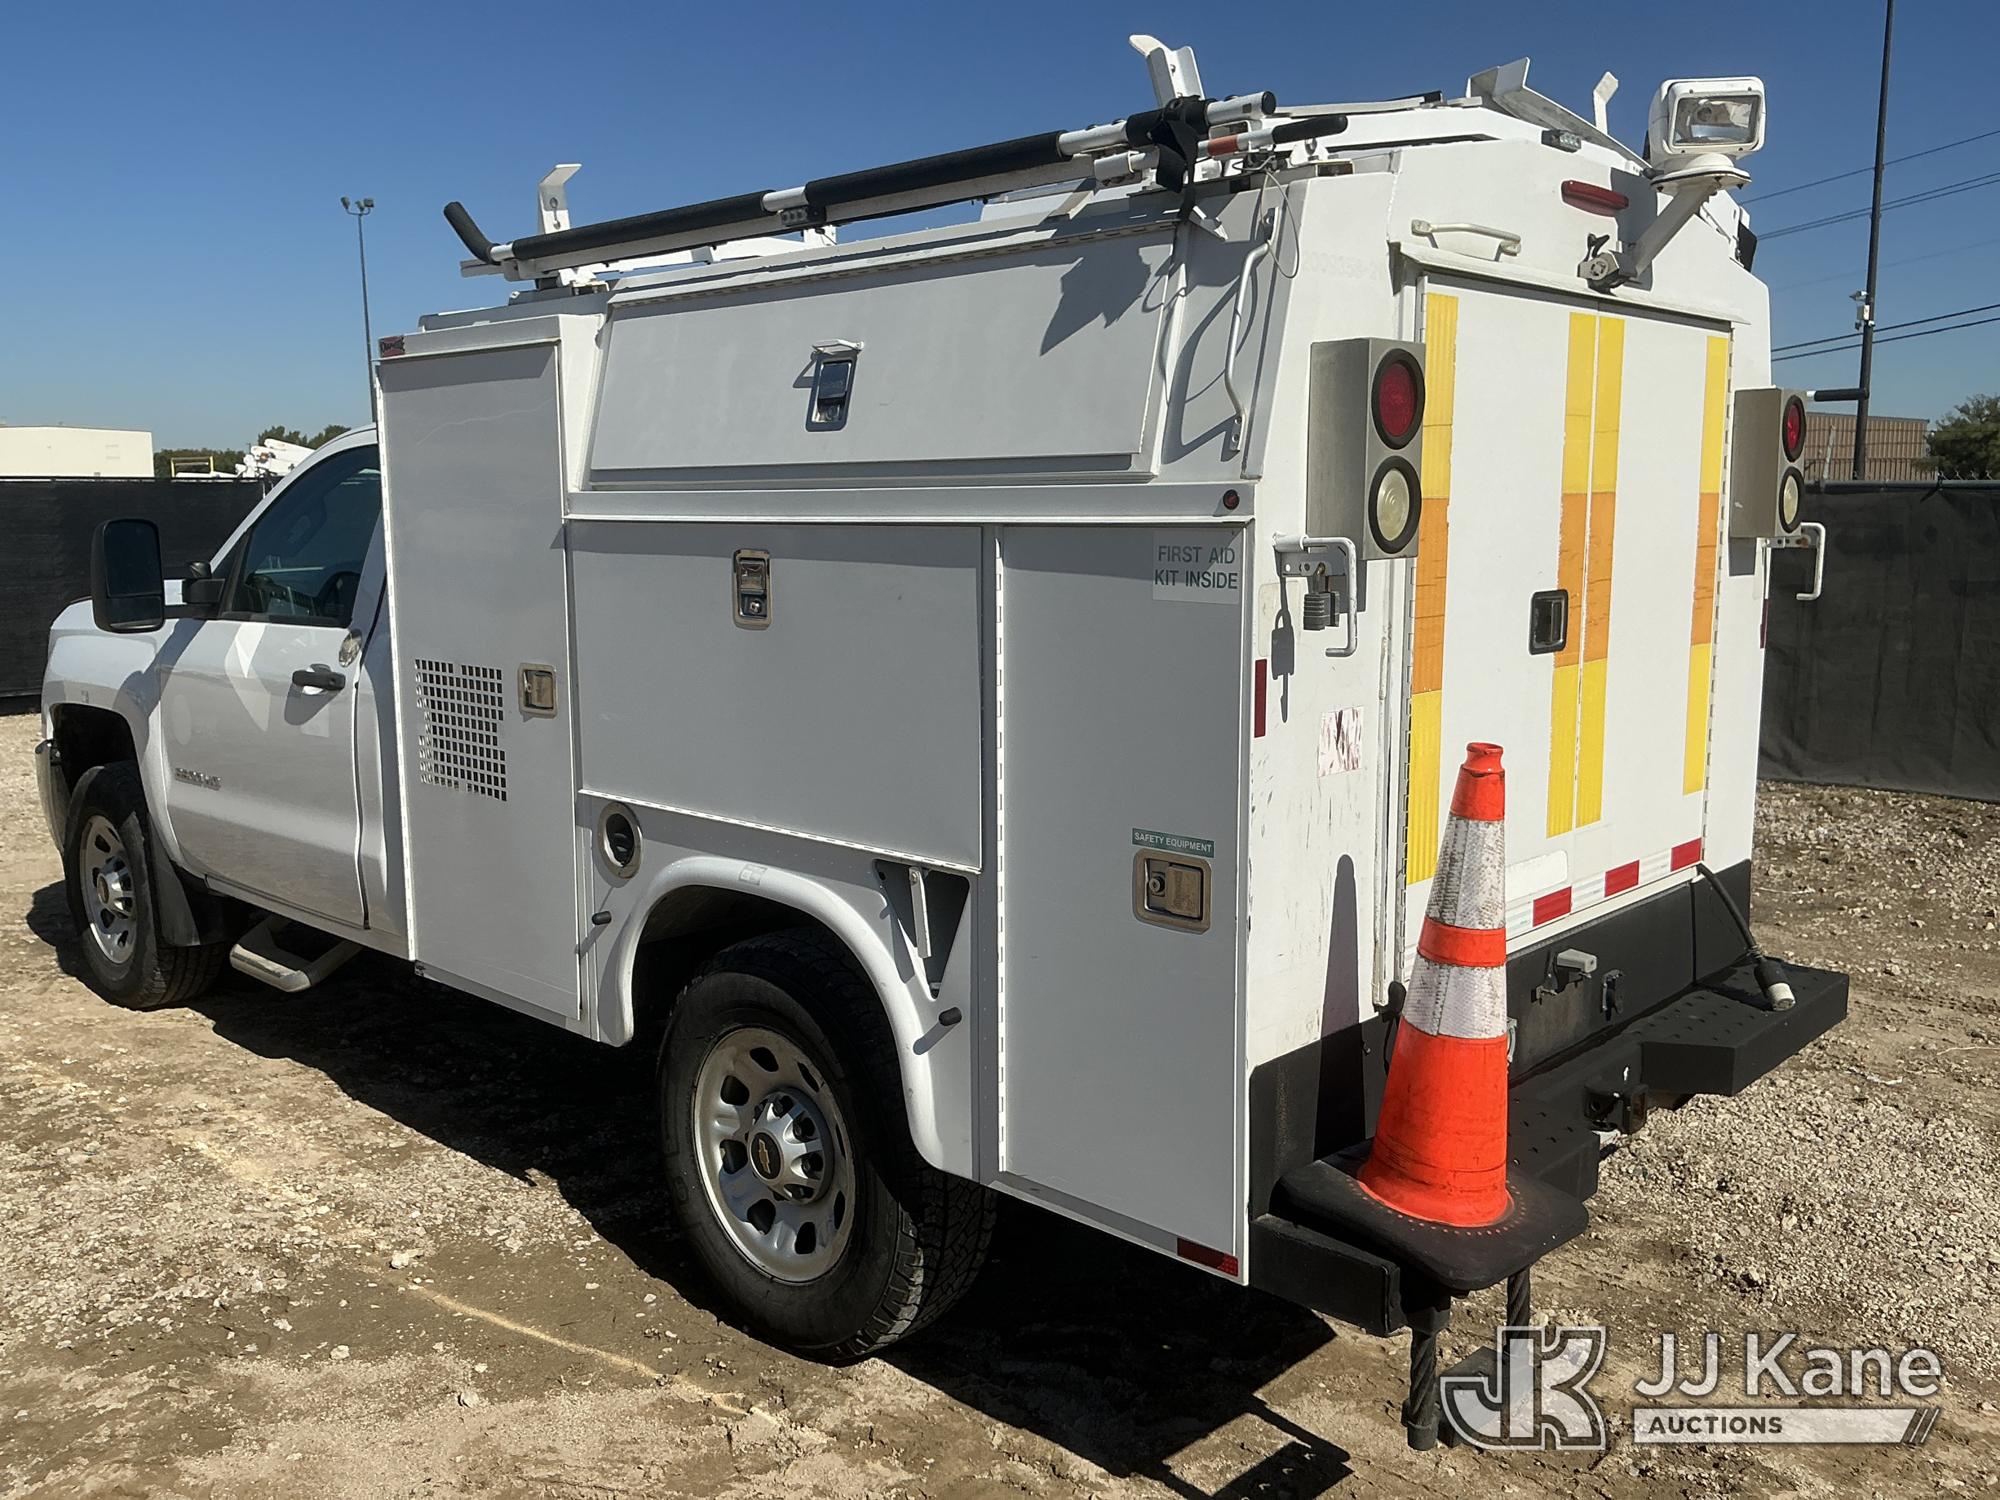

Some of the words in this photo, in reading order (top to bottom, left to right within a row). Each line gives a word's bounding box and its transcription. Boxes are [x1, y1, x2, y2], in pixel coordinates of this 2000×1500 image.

[1158, 545, 1202, 563] FIRST
[1209, 547, 1236, 565] AID
[1154, 569, 1179, 587] KIT
[1185, 571, 1239, 590] INSIDE
[1134, 832, 1164, 845] SAFETY
[1165, 837, 1212, 853] EQUIPMENT
